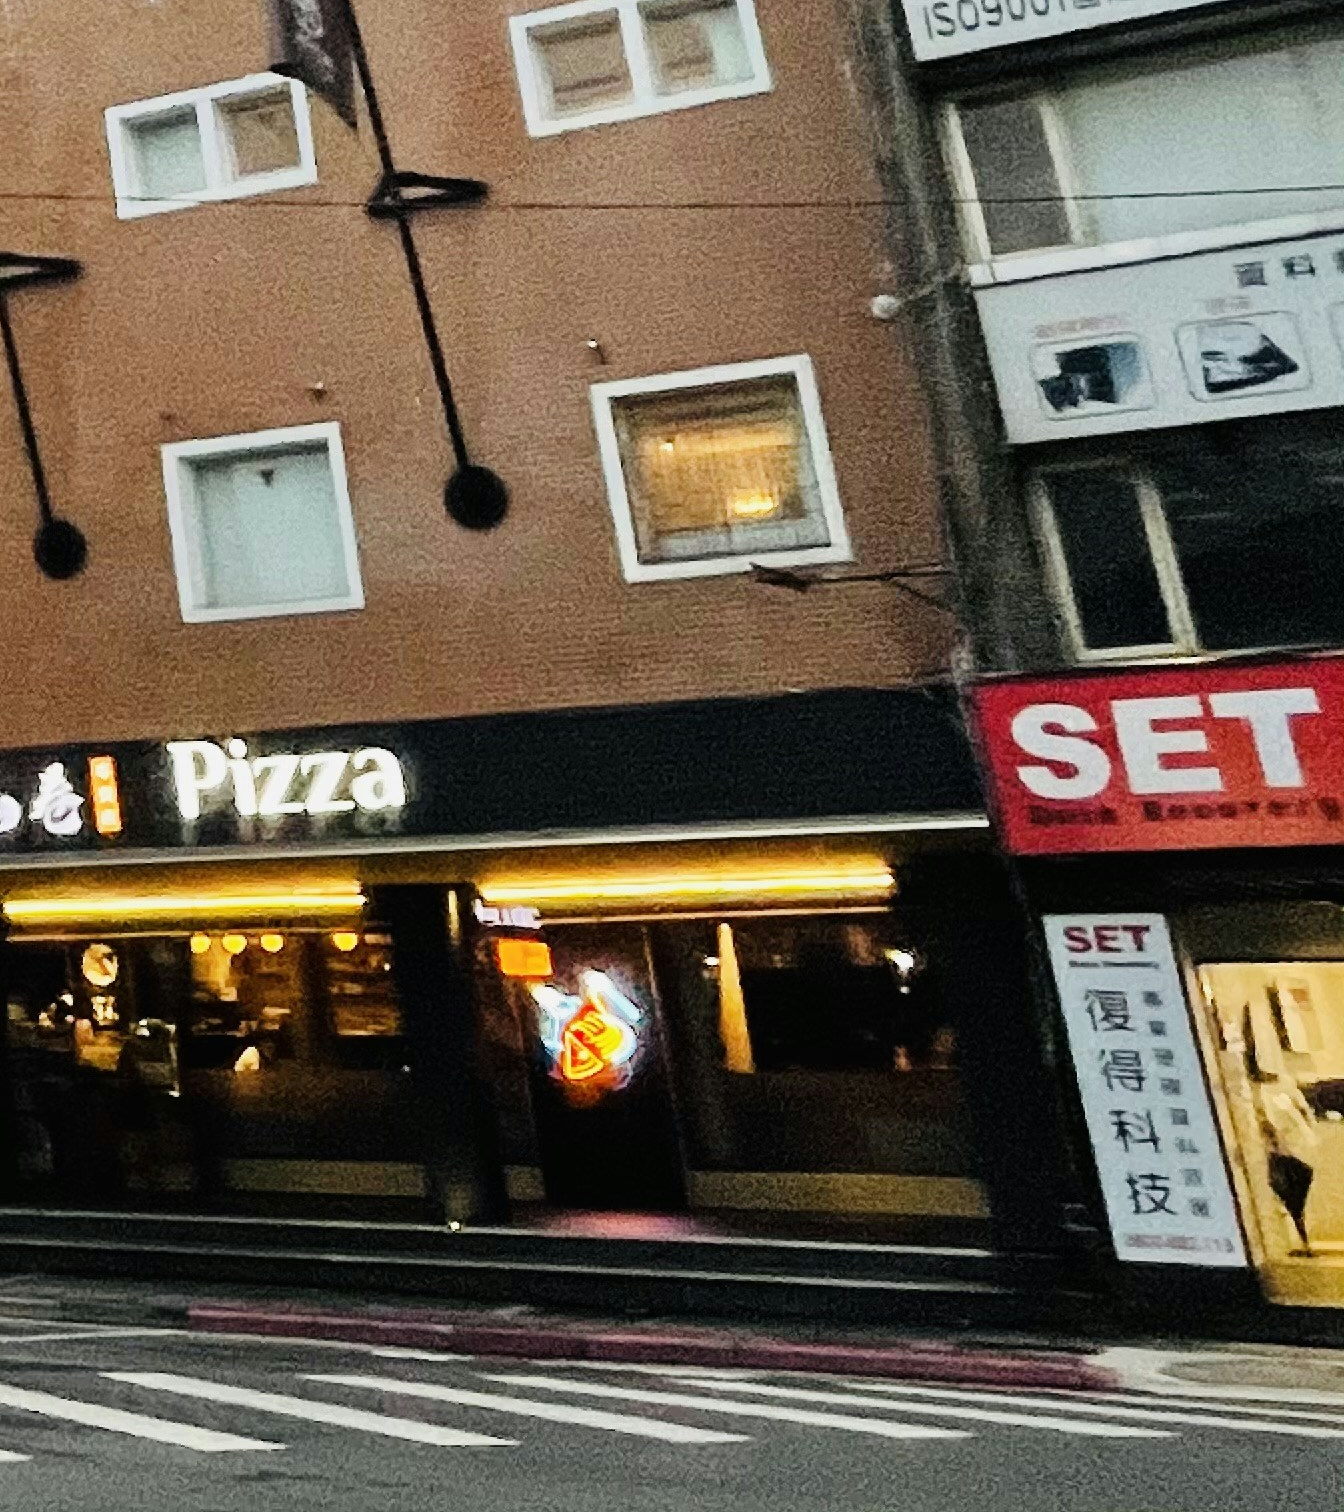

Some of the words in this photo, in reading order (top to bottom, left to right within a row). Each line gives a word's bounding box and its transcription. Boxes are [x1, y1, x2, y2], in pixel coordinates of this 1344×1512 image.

[166, 738, 408, 820] Pizza
[1010, 688, 1322, 801] SET
[1063, 924, 1151, 953] SET
[1084, 989, 1180, 1217] 復得科技
